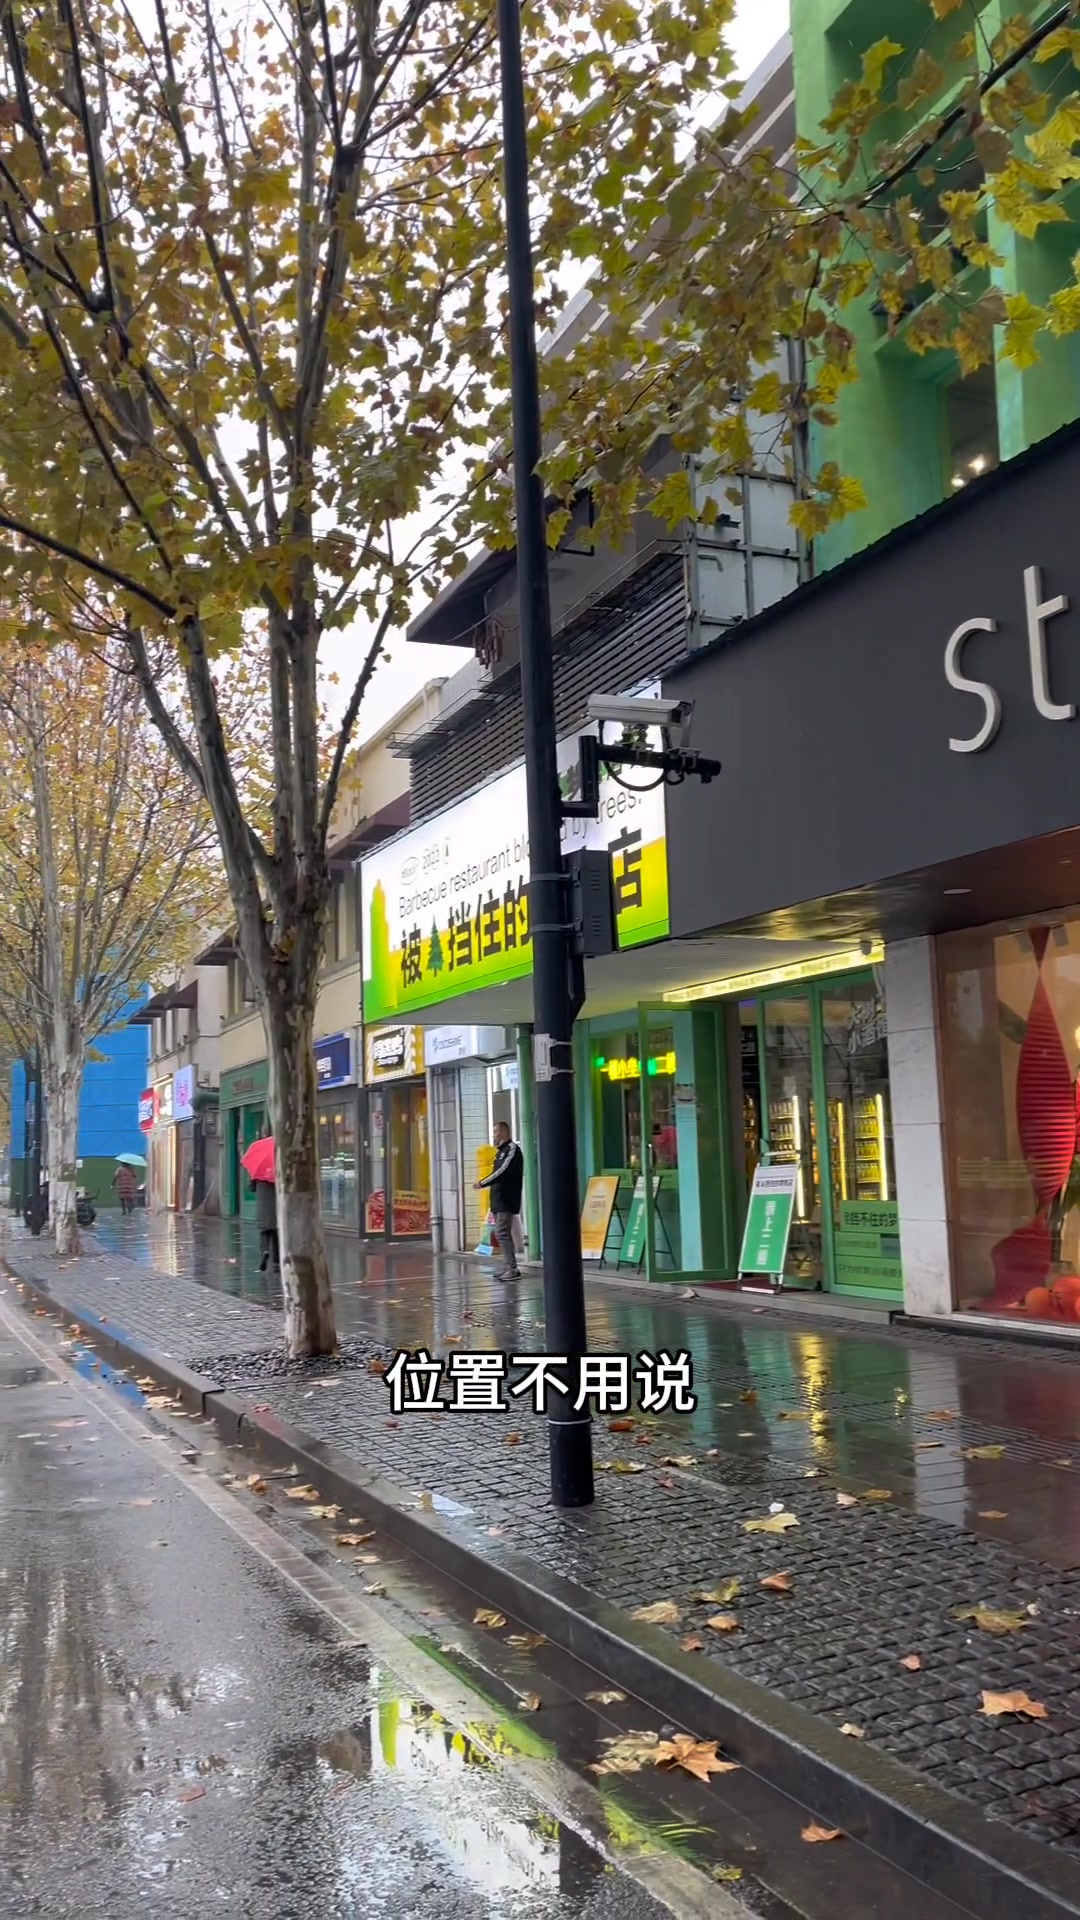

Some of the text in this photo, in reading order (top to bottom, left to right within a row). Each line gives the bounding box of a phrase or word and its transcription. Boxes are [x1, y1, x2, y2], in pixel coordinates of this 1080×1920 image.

[945, 565, 1076, 753] st
[400, 881, 447, 918] Barbecue
[449, 844, 510, 894] restaurant
